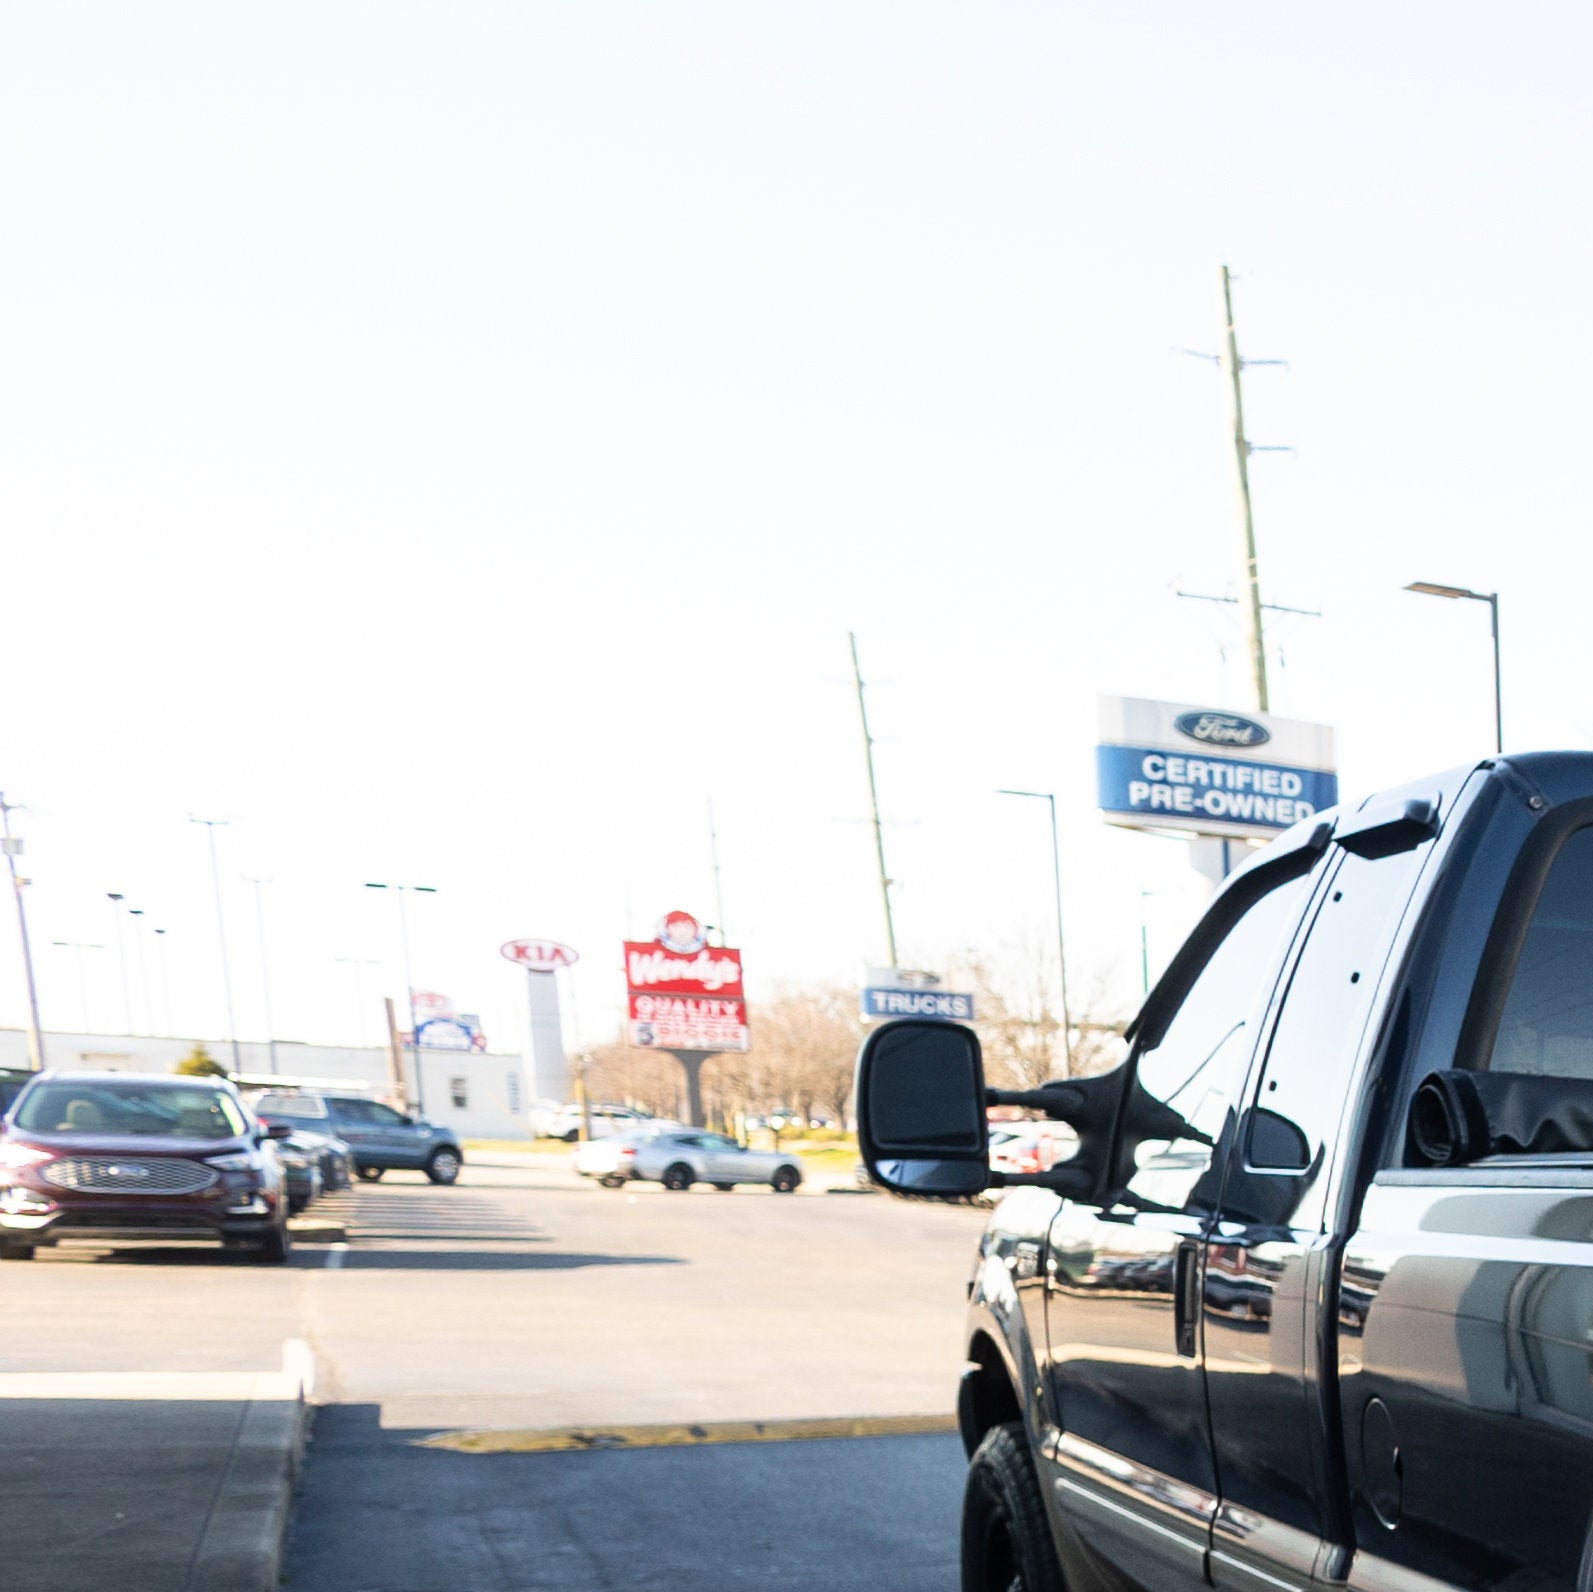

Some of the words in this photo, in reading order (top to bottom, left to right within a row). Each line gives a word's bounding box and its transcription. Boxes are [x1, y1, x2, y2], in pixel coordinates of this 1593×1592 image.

[1193, 714, 1253, 744] Ford
[1142, 754, 1302, 798] CERTIFIED
[1128, 781, 1315, 823] PRE-OWNED
[512, 944, 571, 967] KIA
[628, 949, 740, 991] Wendy's
[635, 995, 741, 1017] QUALITY
[872, 990, 969, 1017] TRUCKS
